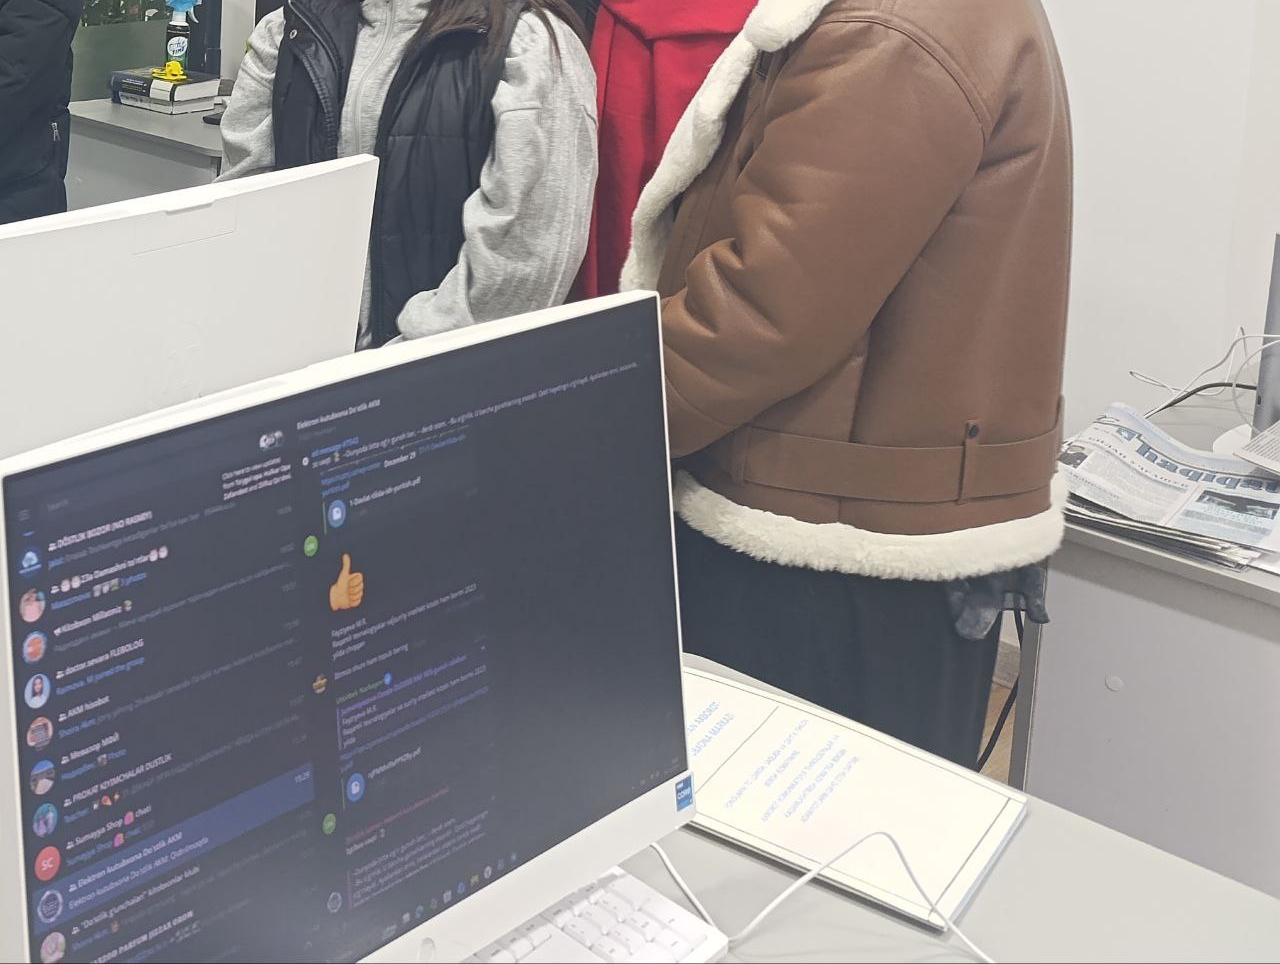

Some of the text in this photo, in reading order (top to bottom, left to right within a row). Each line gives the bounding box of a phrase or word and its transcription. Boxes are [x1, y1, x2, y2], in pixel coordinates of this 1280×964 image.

[383, 453, 407, 468] December
[78, 867, 105, 888] Elektron
[106, 849, 142, 874] kutubxona
[167, 830, 182, 845] AKM
